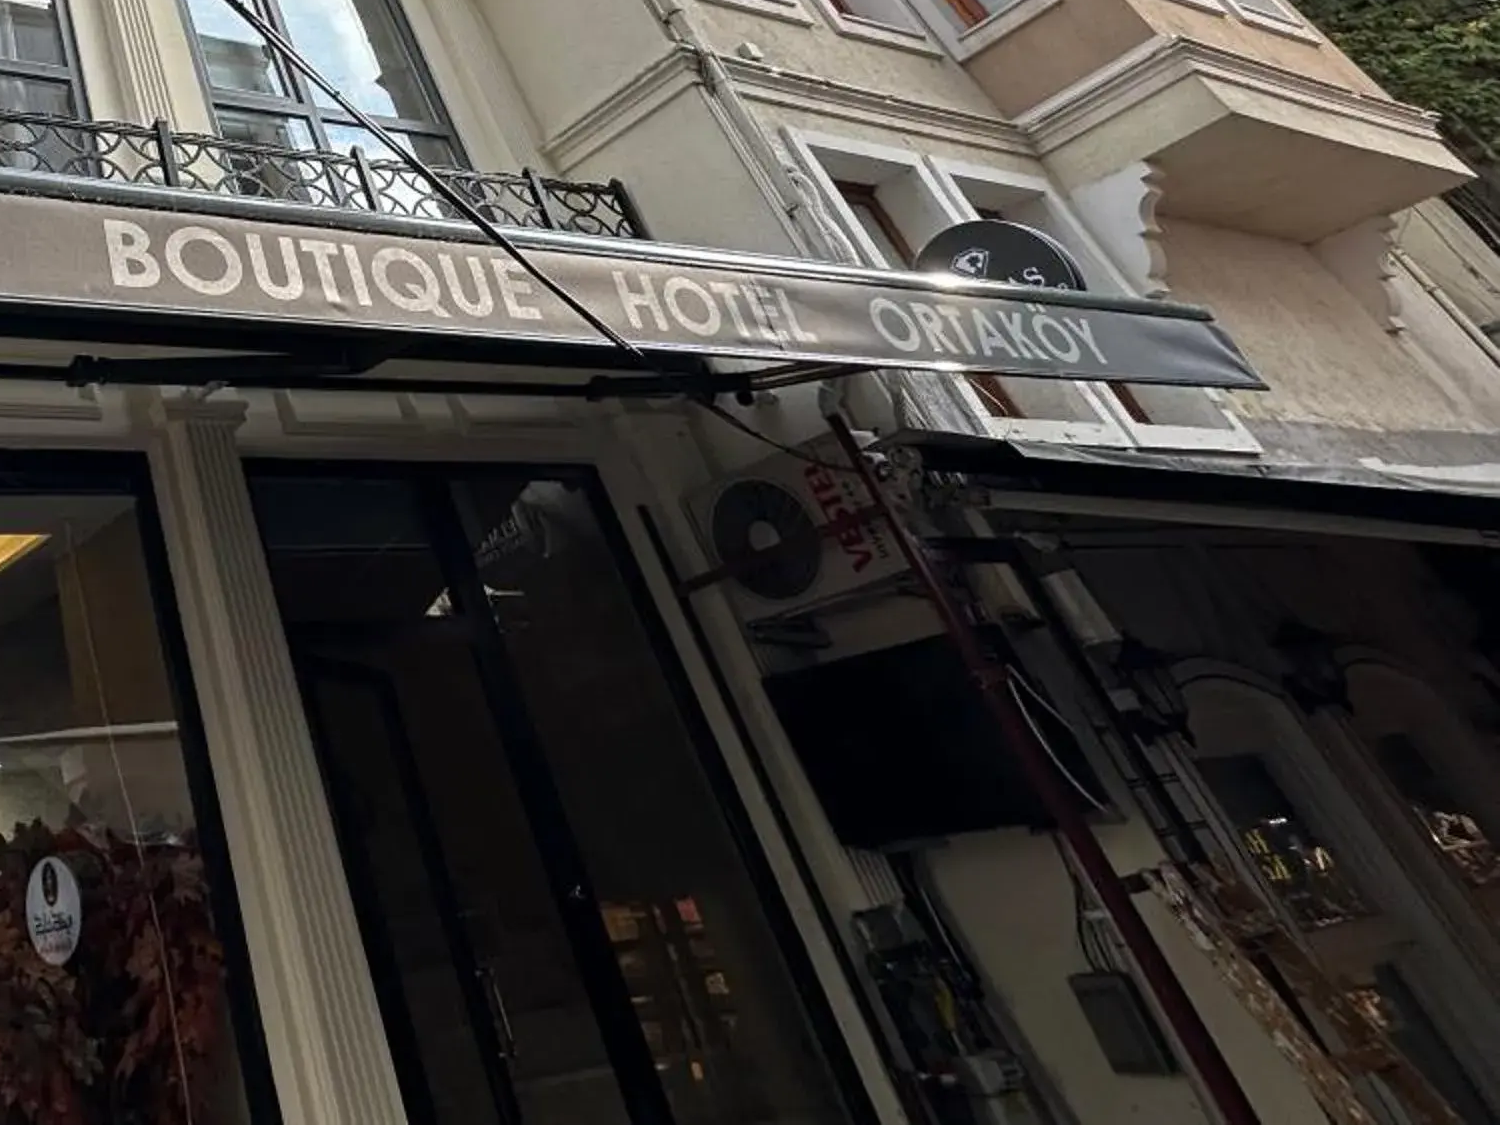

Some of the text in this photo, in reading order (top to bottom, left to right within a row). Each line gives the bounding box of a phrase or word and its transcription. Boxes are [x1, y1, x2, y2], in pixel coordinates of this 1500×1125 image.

[102, 217, 544, 321] BOUTIQUE
[612, 270, 819, 344] HOTEL
[869, 297, 1108, 365] ORTAKÖY
